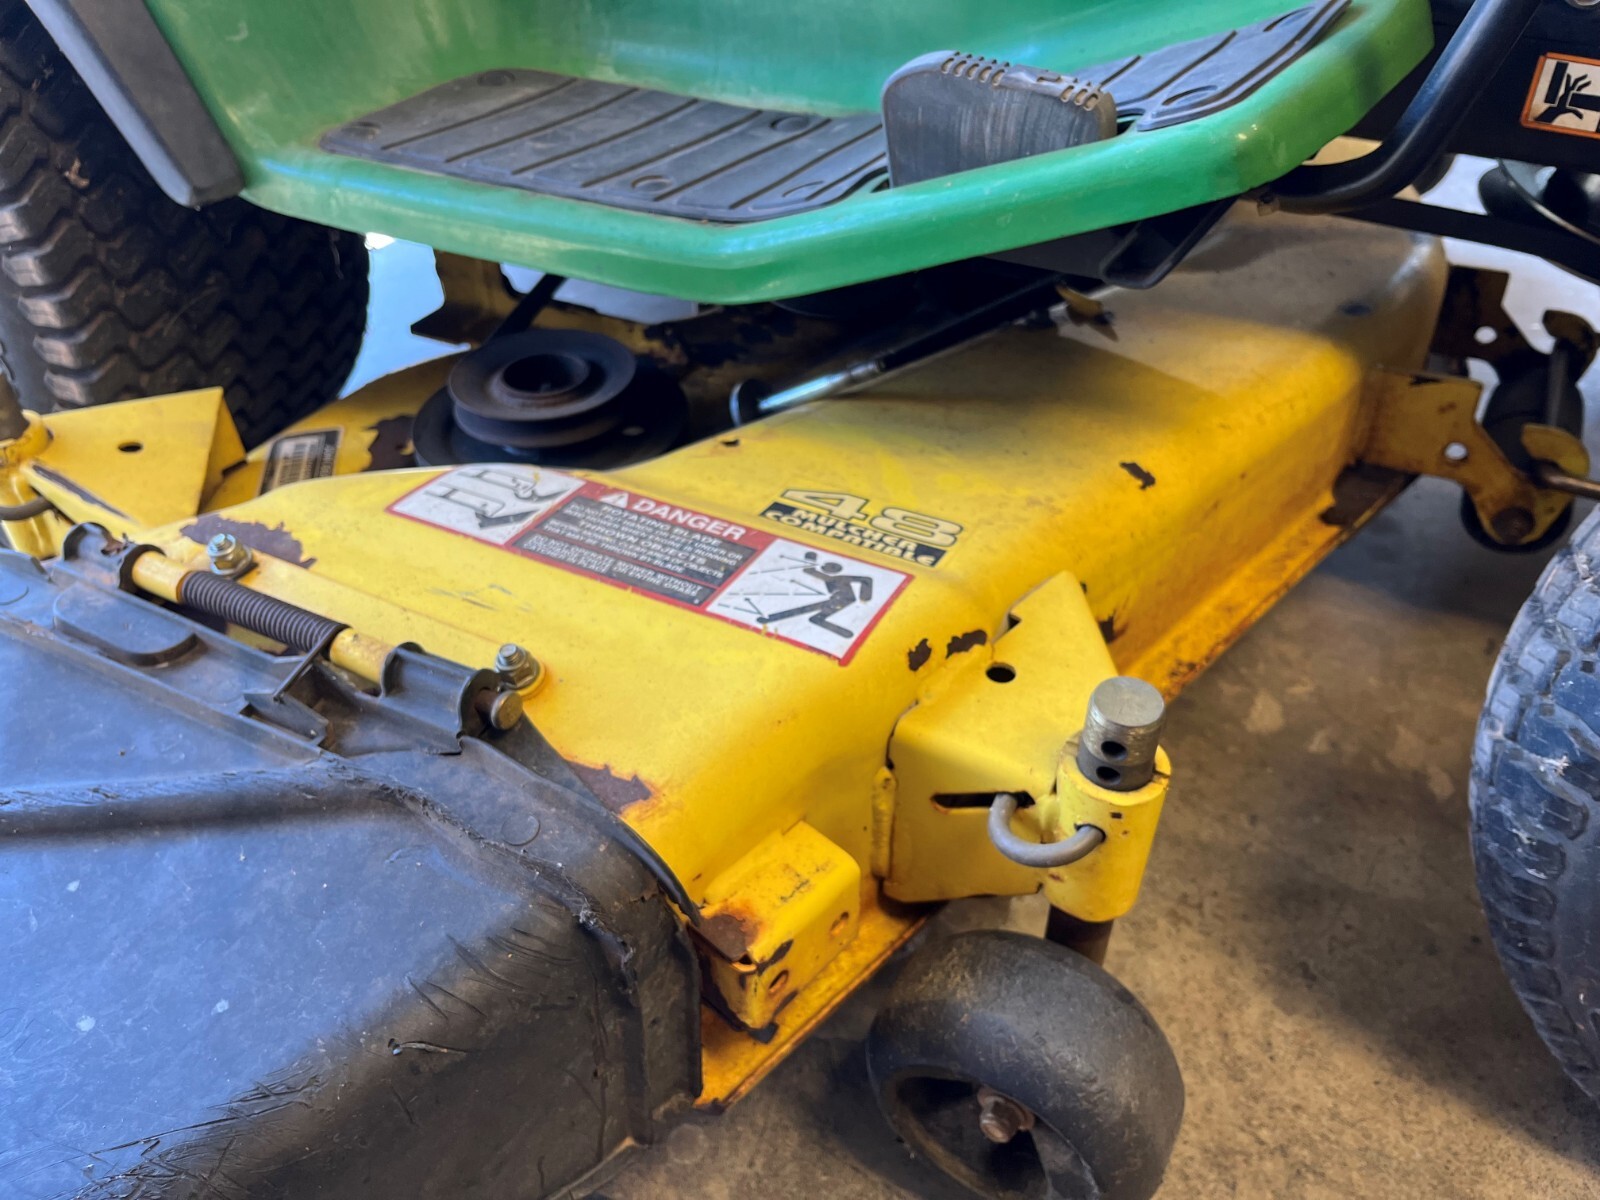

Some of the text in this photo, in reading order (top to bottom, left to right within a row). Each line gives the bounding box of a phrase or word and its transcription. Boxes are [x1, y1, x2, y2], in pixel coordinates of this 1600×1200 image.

[631, 498, 747, 541] DANGER
[780, 488, 962, 548] 48
[792, 508, 917, 552] MULCHER
[575, 519, 709, 565] THROWN OBJECTS
[670, 525, 724, 547] BLADE
[692, 541, 728, 555] UNDER
[724, 550, 745, 561] OR
[763, 509, 936, 566] COMPATIBLE
[651, 558, 686, 573] BLADE
[692, 548, 738, 566] RUNNING
[653, 572, 703, 592] WITHOUT
